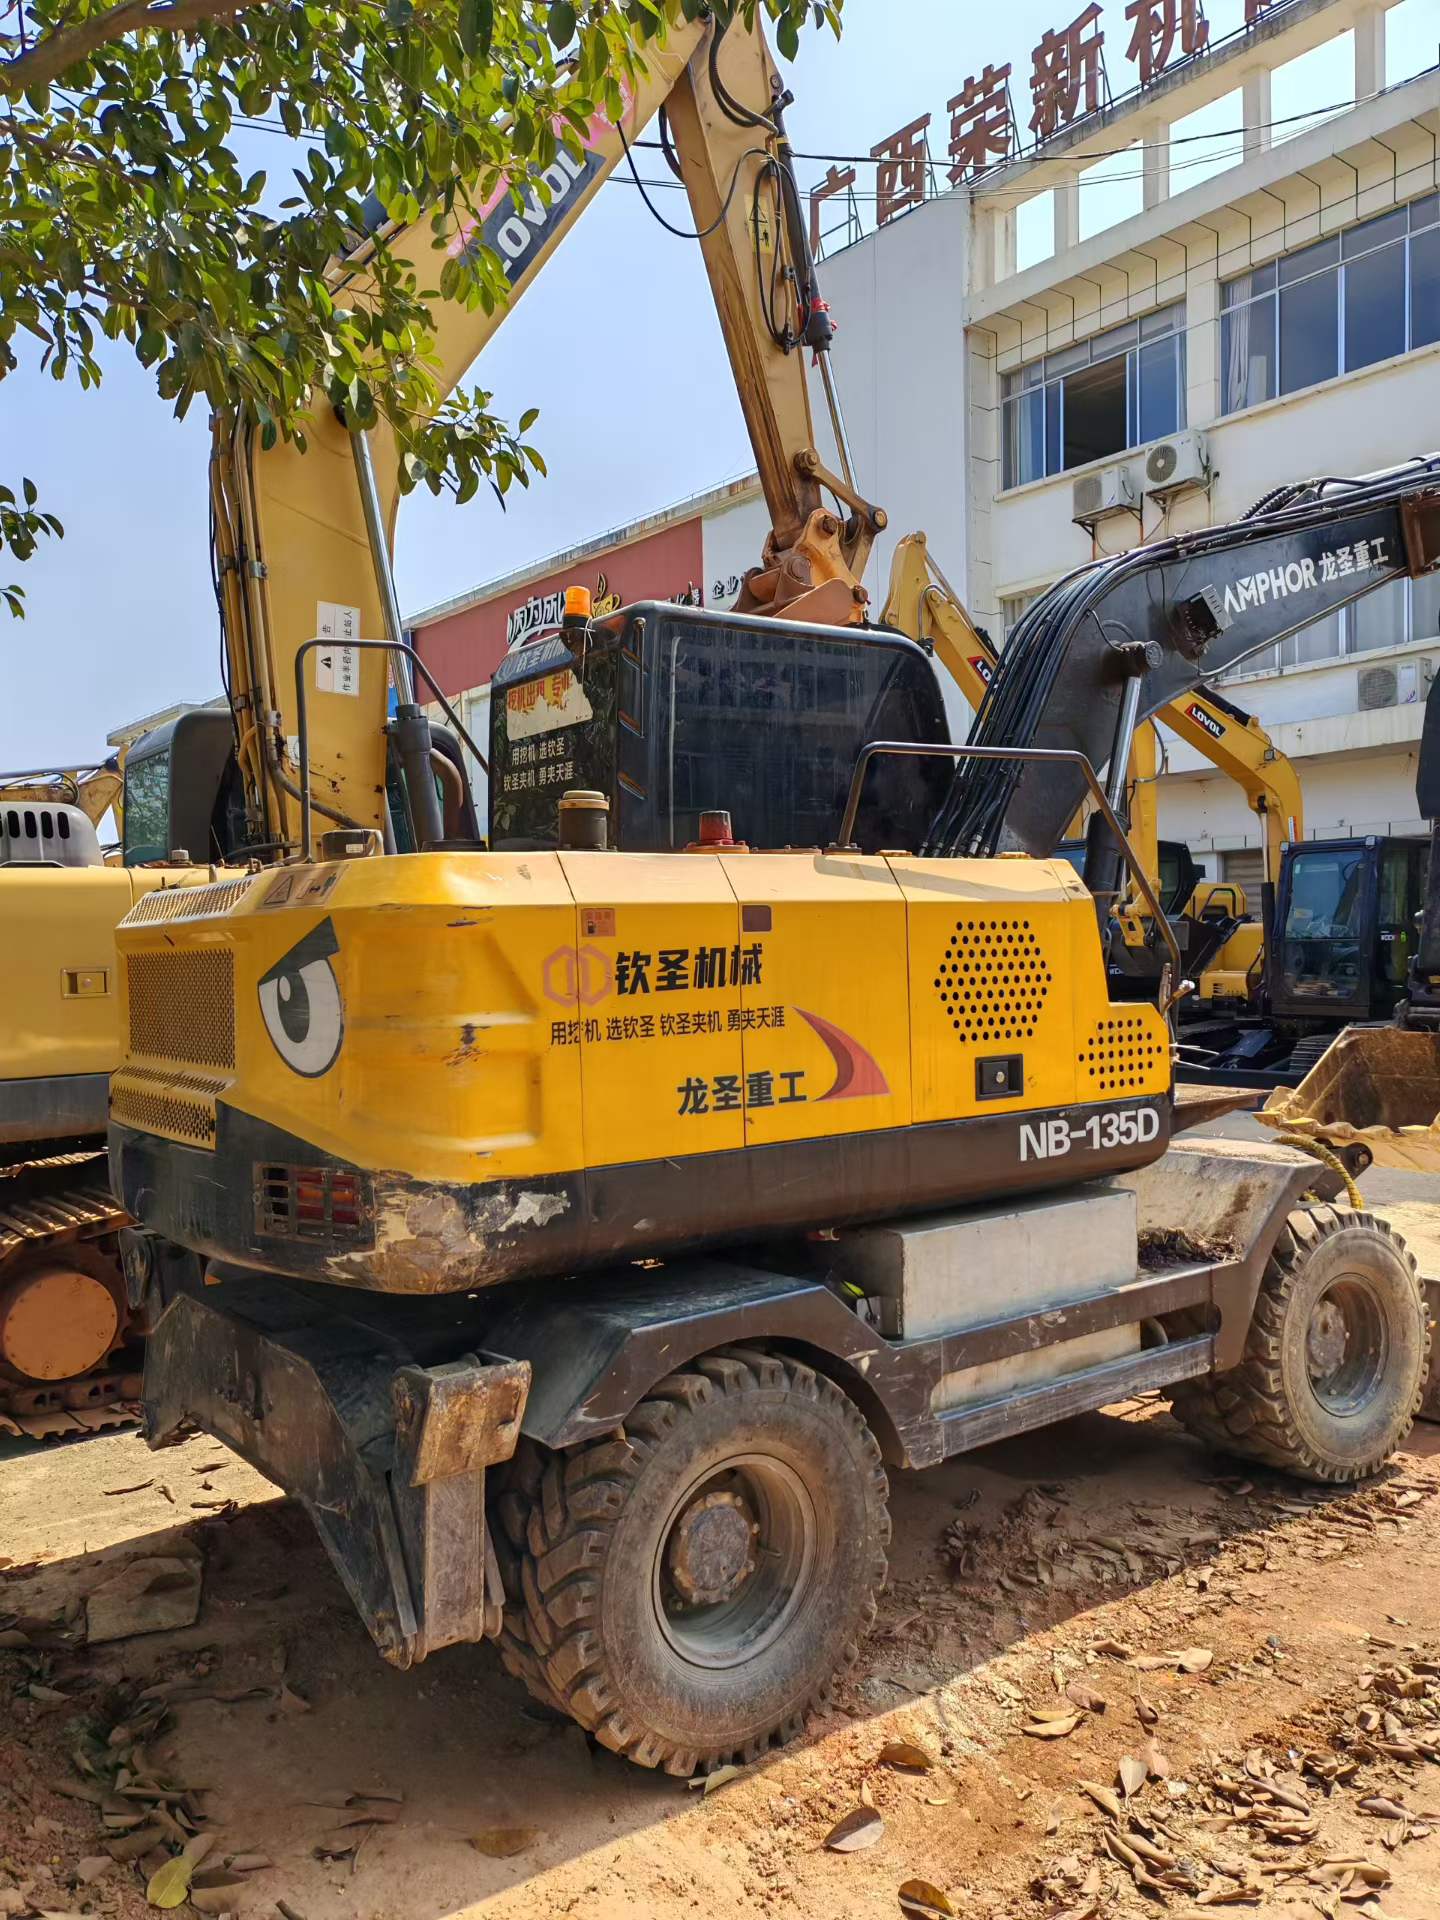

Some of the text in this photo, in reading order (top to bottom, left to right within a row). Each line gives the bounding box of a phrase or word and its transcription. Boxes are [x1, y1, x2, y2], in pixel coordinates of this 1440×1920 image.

[1318, 536, 1390, 583] 龙圣重工
[1191, 704, 1222, 736] LOVOL
[511, 736, 566, 766] 用挖机 选钦圣
[503, 760, 575, 792] 钦圣夹机 勇夹天涯
[614, 942, 763, 996] 钦圣机械
[550, 1005, 785, 1046] 用挖机 选钦圣 钦圣夹机 勇夹天涯
[676, 1070, 808, 1116] 龙圣重工
[1019, 1107, 1160, 1162] NB-135D
